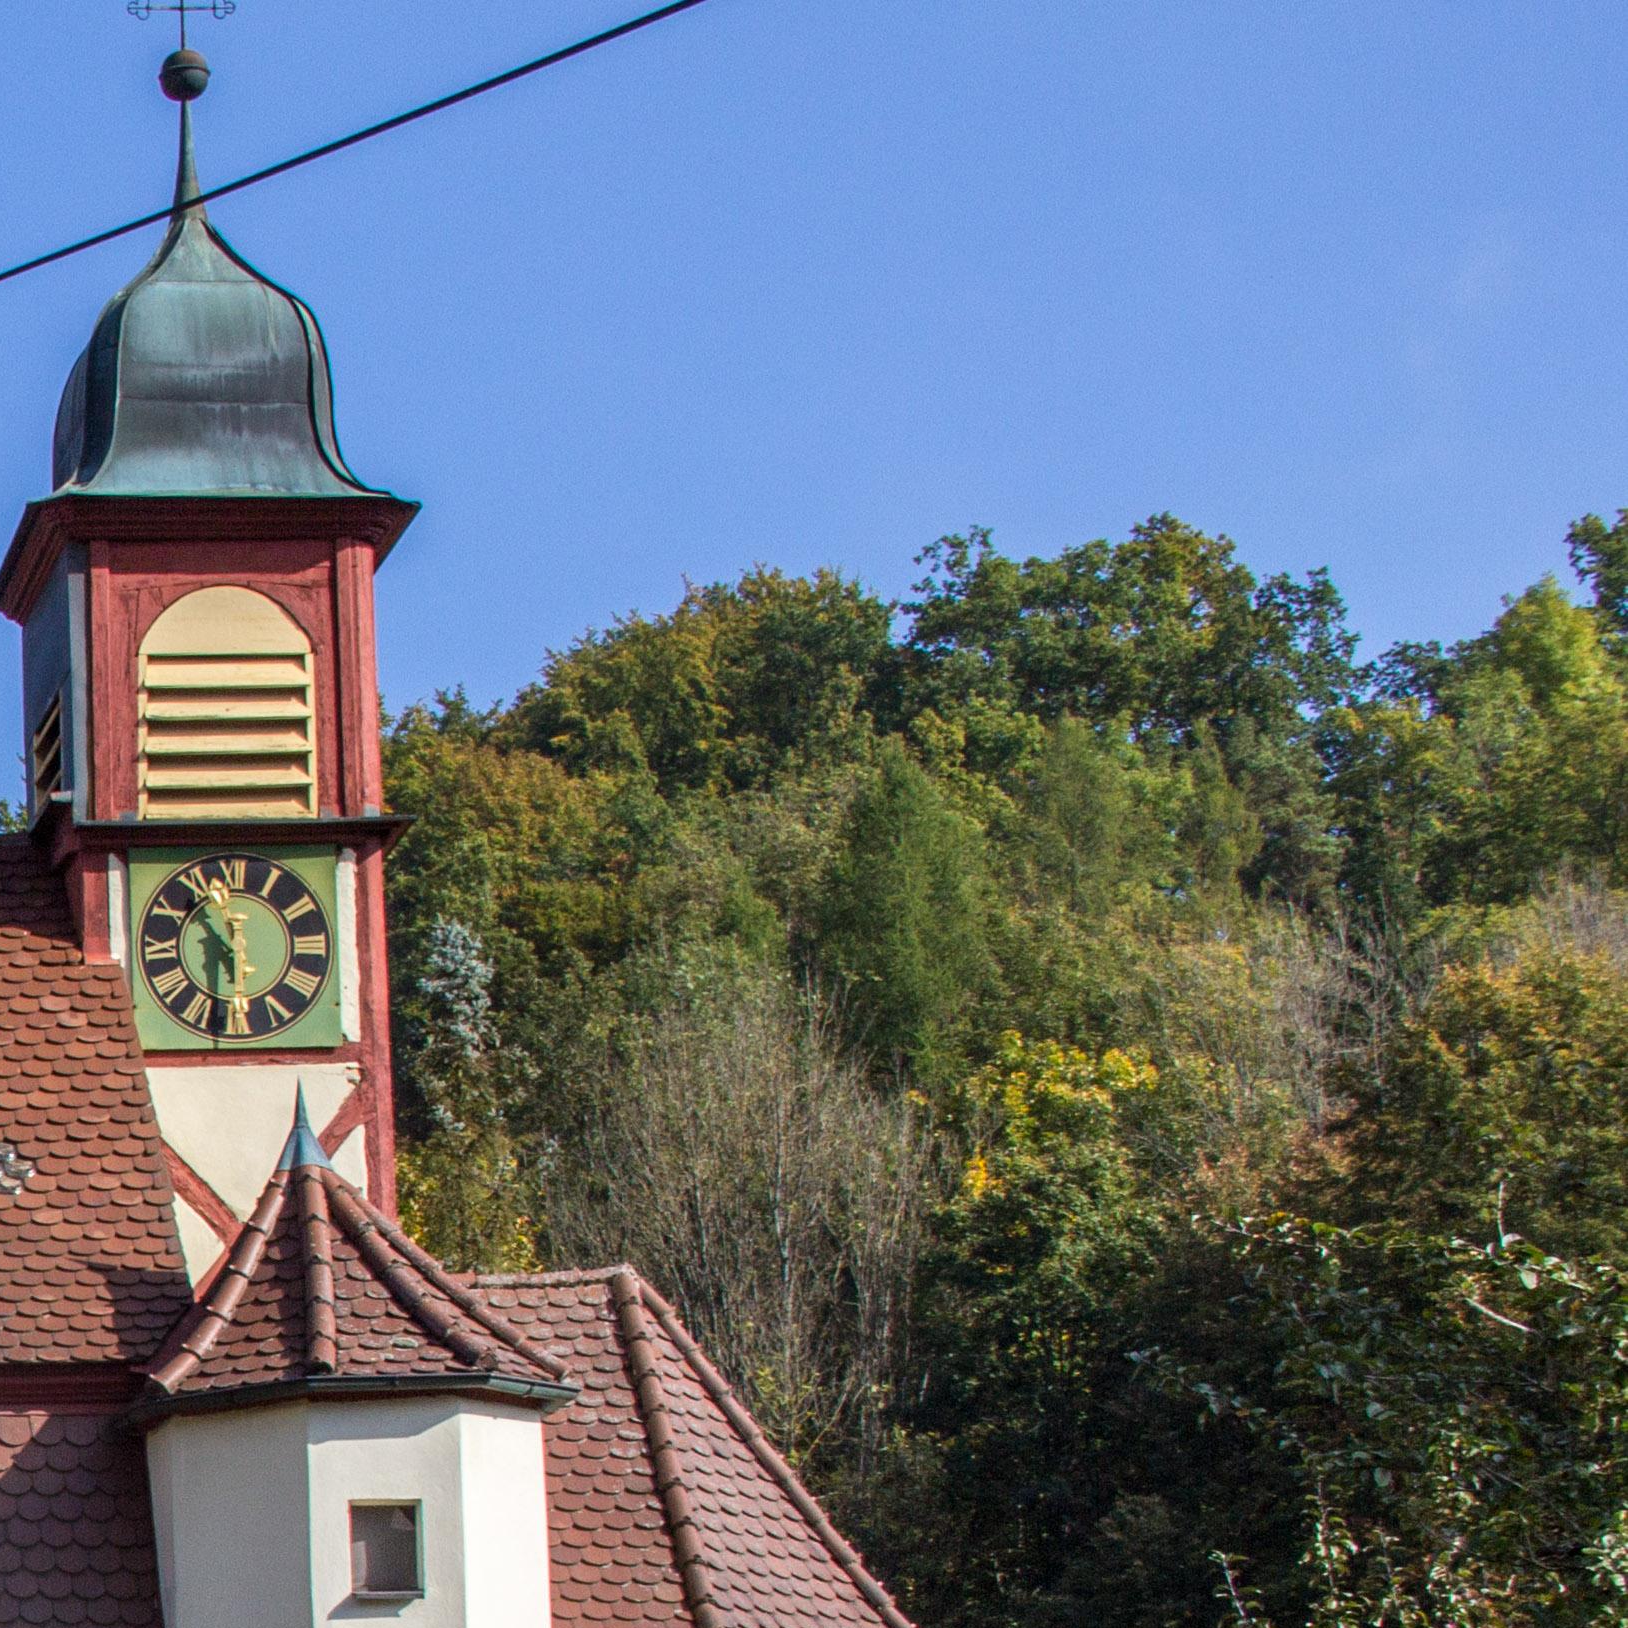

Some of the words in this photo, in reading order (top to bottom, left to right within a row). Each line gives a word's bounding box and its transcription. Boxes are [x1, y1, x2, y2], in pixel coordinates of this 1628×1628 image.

[176, 865, 211, 902] XI
[218, 859, 247, 889] XII
[257, 867, 283, 898] I
[151, 894, 188, 926] X
[281, 893, 318, 923] II
[145, 934, 178, 963] IX
[292, 932, 326, 958] III
[150, 965, 189, 1006] VIII
[283, 965, 322, 1001] IIII
[179, 991, 212, 1029] VII
[264, 995, 295, 1028] V
